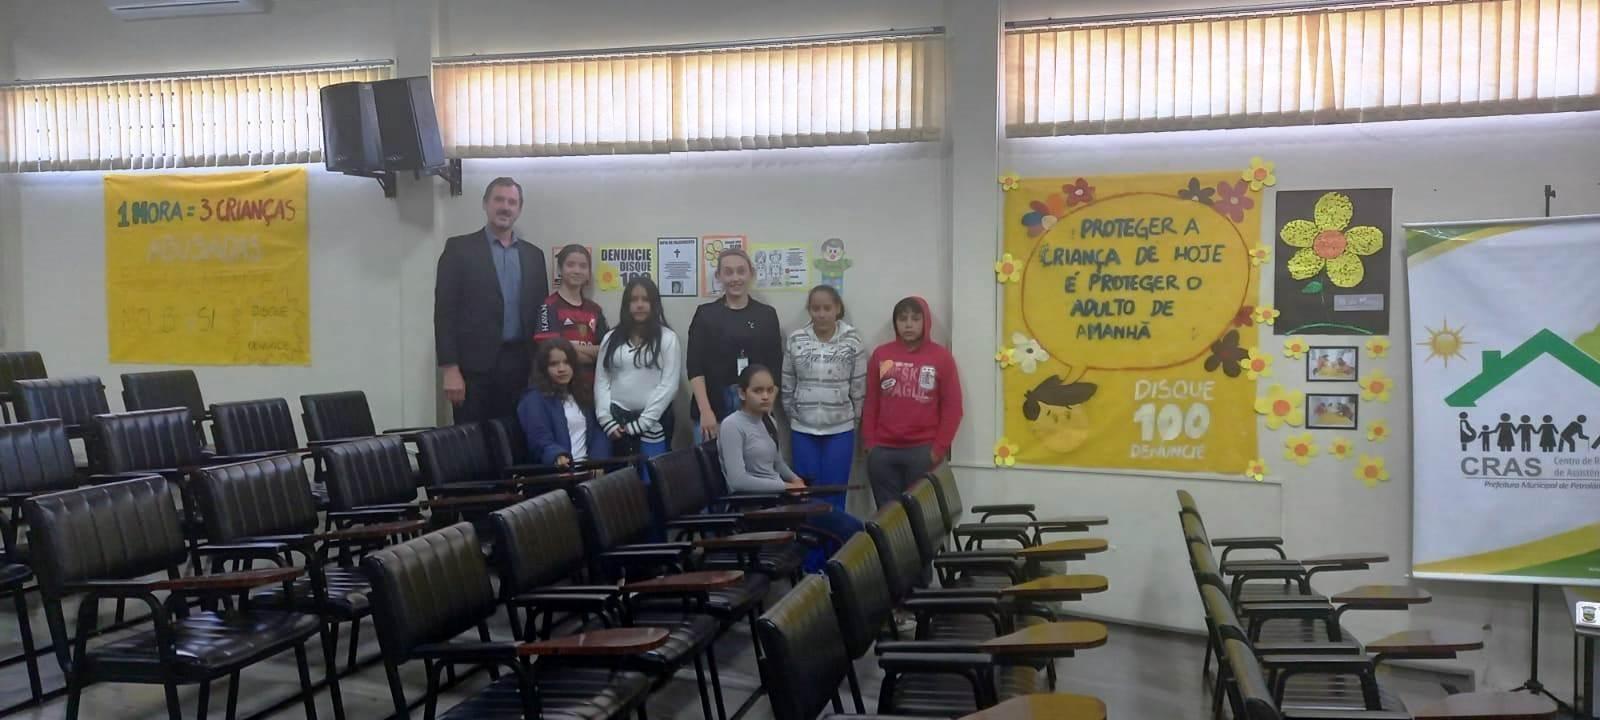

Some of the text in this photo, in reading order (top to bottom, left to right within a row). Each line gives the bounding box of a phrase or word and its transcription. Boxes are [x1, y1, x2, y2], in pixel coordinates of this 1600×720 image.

[117, 201, 130, 227] 1
[199, 198, 213, 222] 3
[216, 197, 296, 226] CRIANÇAS
[1080, 217, 1200, 240] PROTEGER A
[601, 248, 652, 262] DENUNCIE
[1040, 244, 1226, 272] CRIANÇA DE HOJE
[620, 261, 651, 272] DISQUE
[1065, 271, 1203, 293] É PROTEGER O
[1070, 299, 1175, 318] ADULTO DE
[1076, 321, 1151, 340] AMANHÃ
[1134, 379, 1216, 401] DISQUE
[1132, 403, 1210, 442] 100
[1130, 443, 1206, 460] DENUNCIE
[1460, 457, 1542, 477] CRAS
[1553, 456, 1580, 465] Centro
[1582, 456, 1593, 465] de
[1553, 467, 1565, 477] de
[1484, 480, 1520, 490] Prefeitura
[1521, 480, 1558, 490] Municipal
[1558, 481, 1569, 490] de
